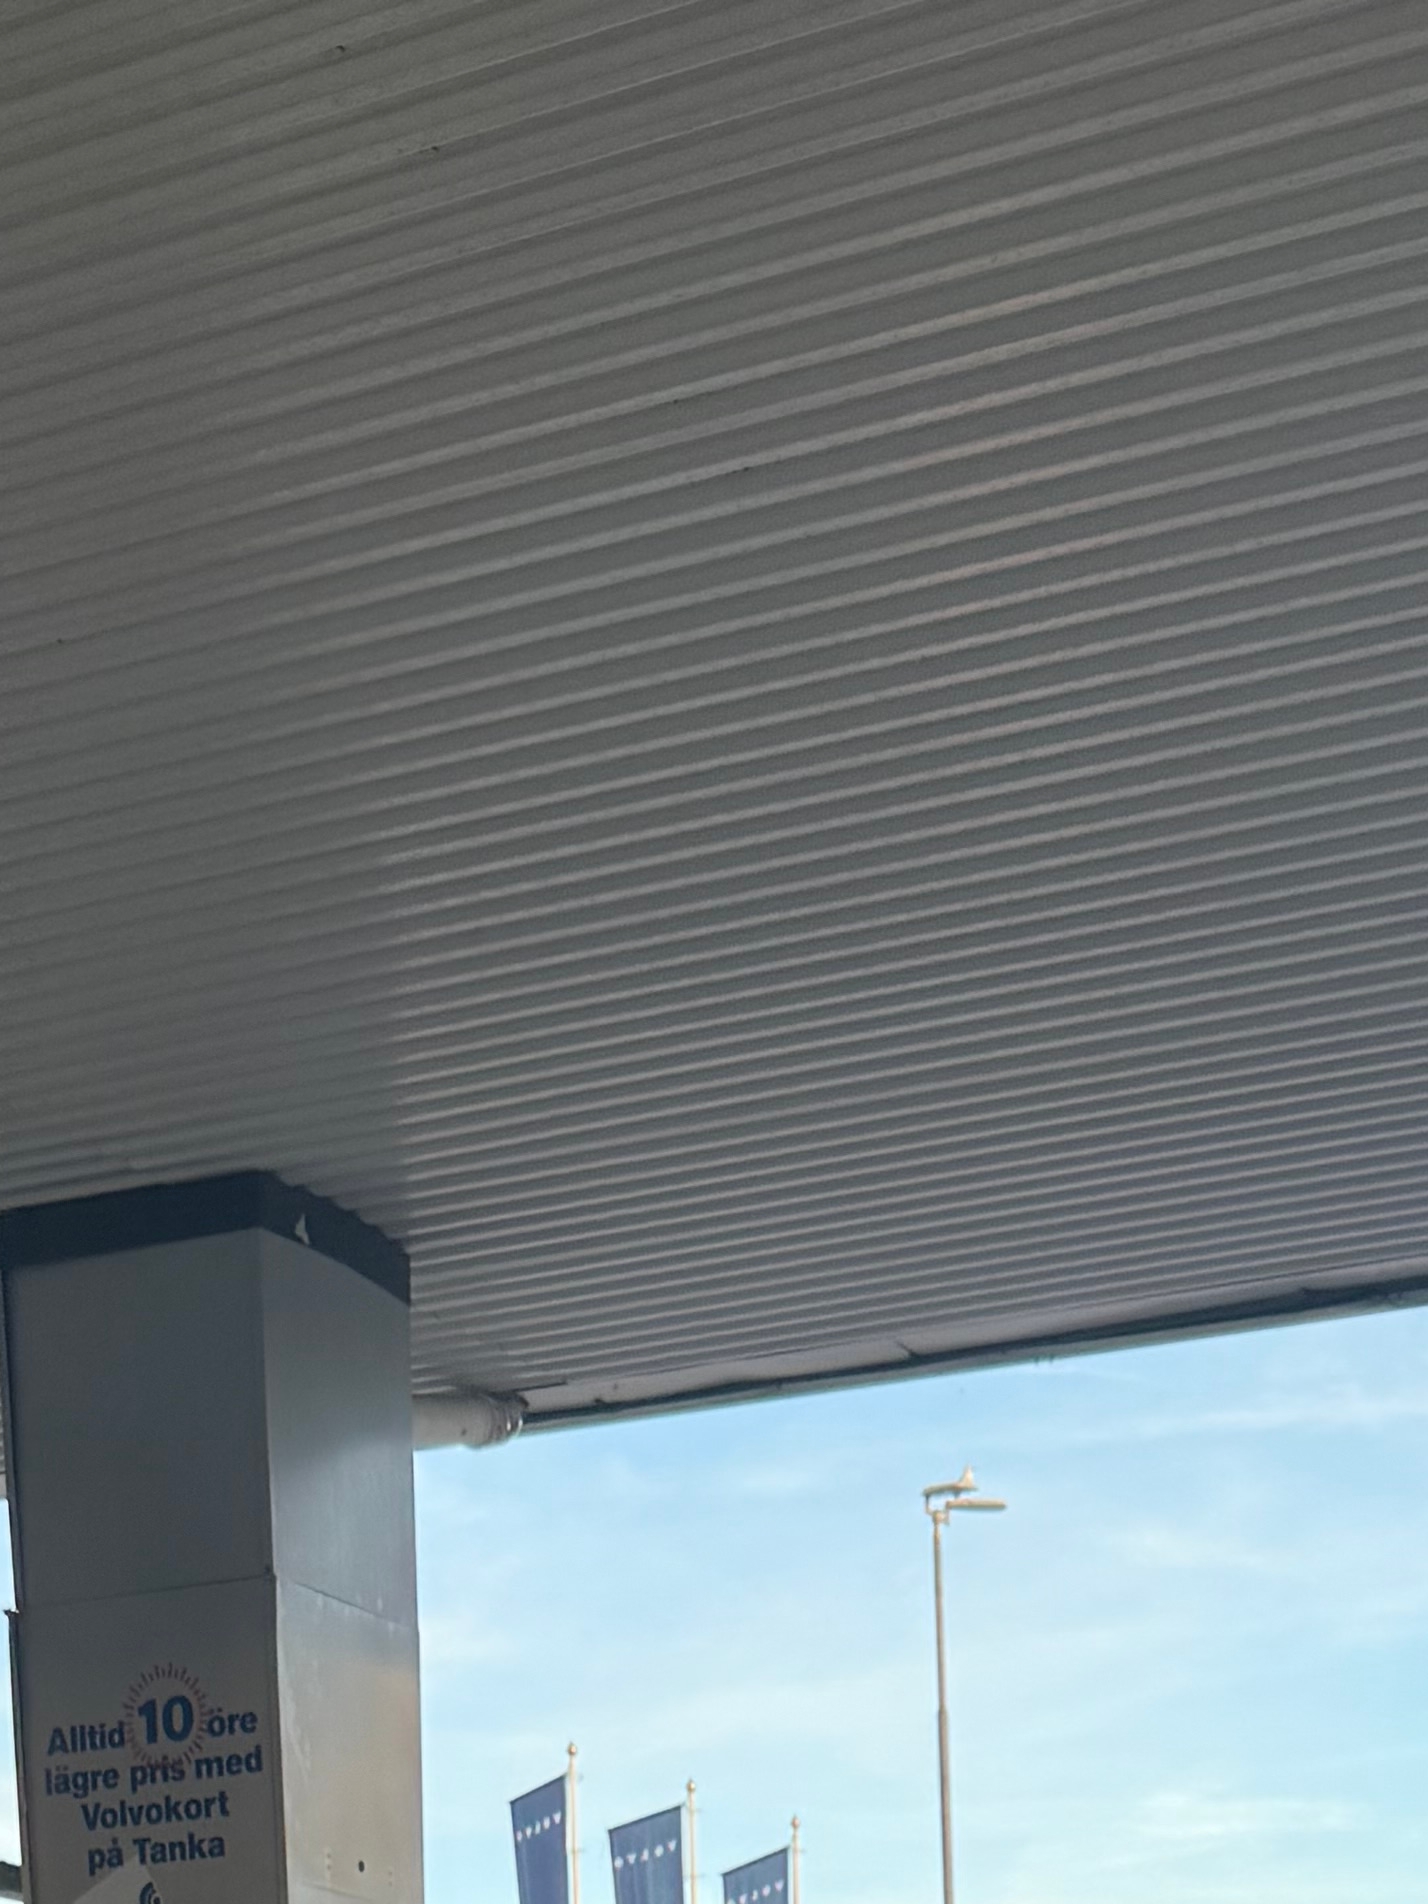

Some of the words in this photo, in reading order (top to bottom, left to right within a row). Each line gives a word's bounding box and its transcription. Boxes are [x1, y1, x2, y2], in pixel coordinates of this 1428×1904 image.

[47, 1720, 126, 1757] Alltid
[137, 1694, 195, 1745] 10
[206, 1707, 259, 1739] öre
[44, 1766, 121, 1799] lägre
[129, 1755, 186, 1794] pris
[193, 1745, 263, 1779] med
[80, 1790, 231, 1831] Volvokort
[87, 1837, 124, 1876] på
[132, 1832, 226, 1867] Tanka
